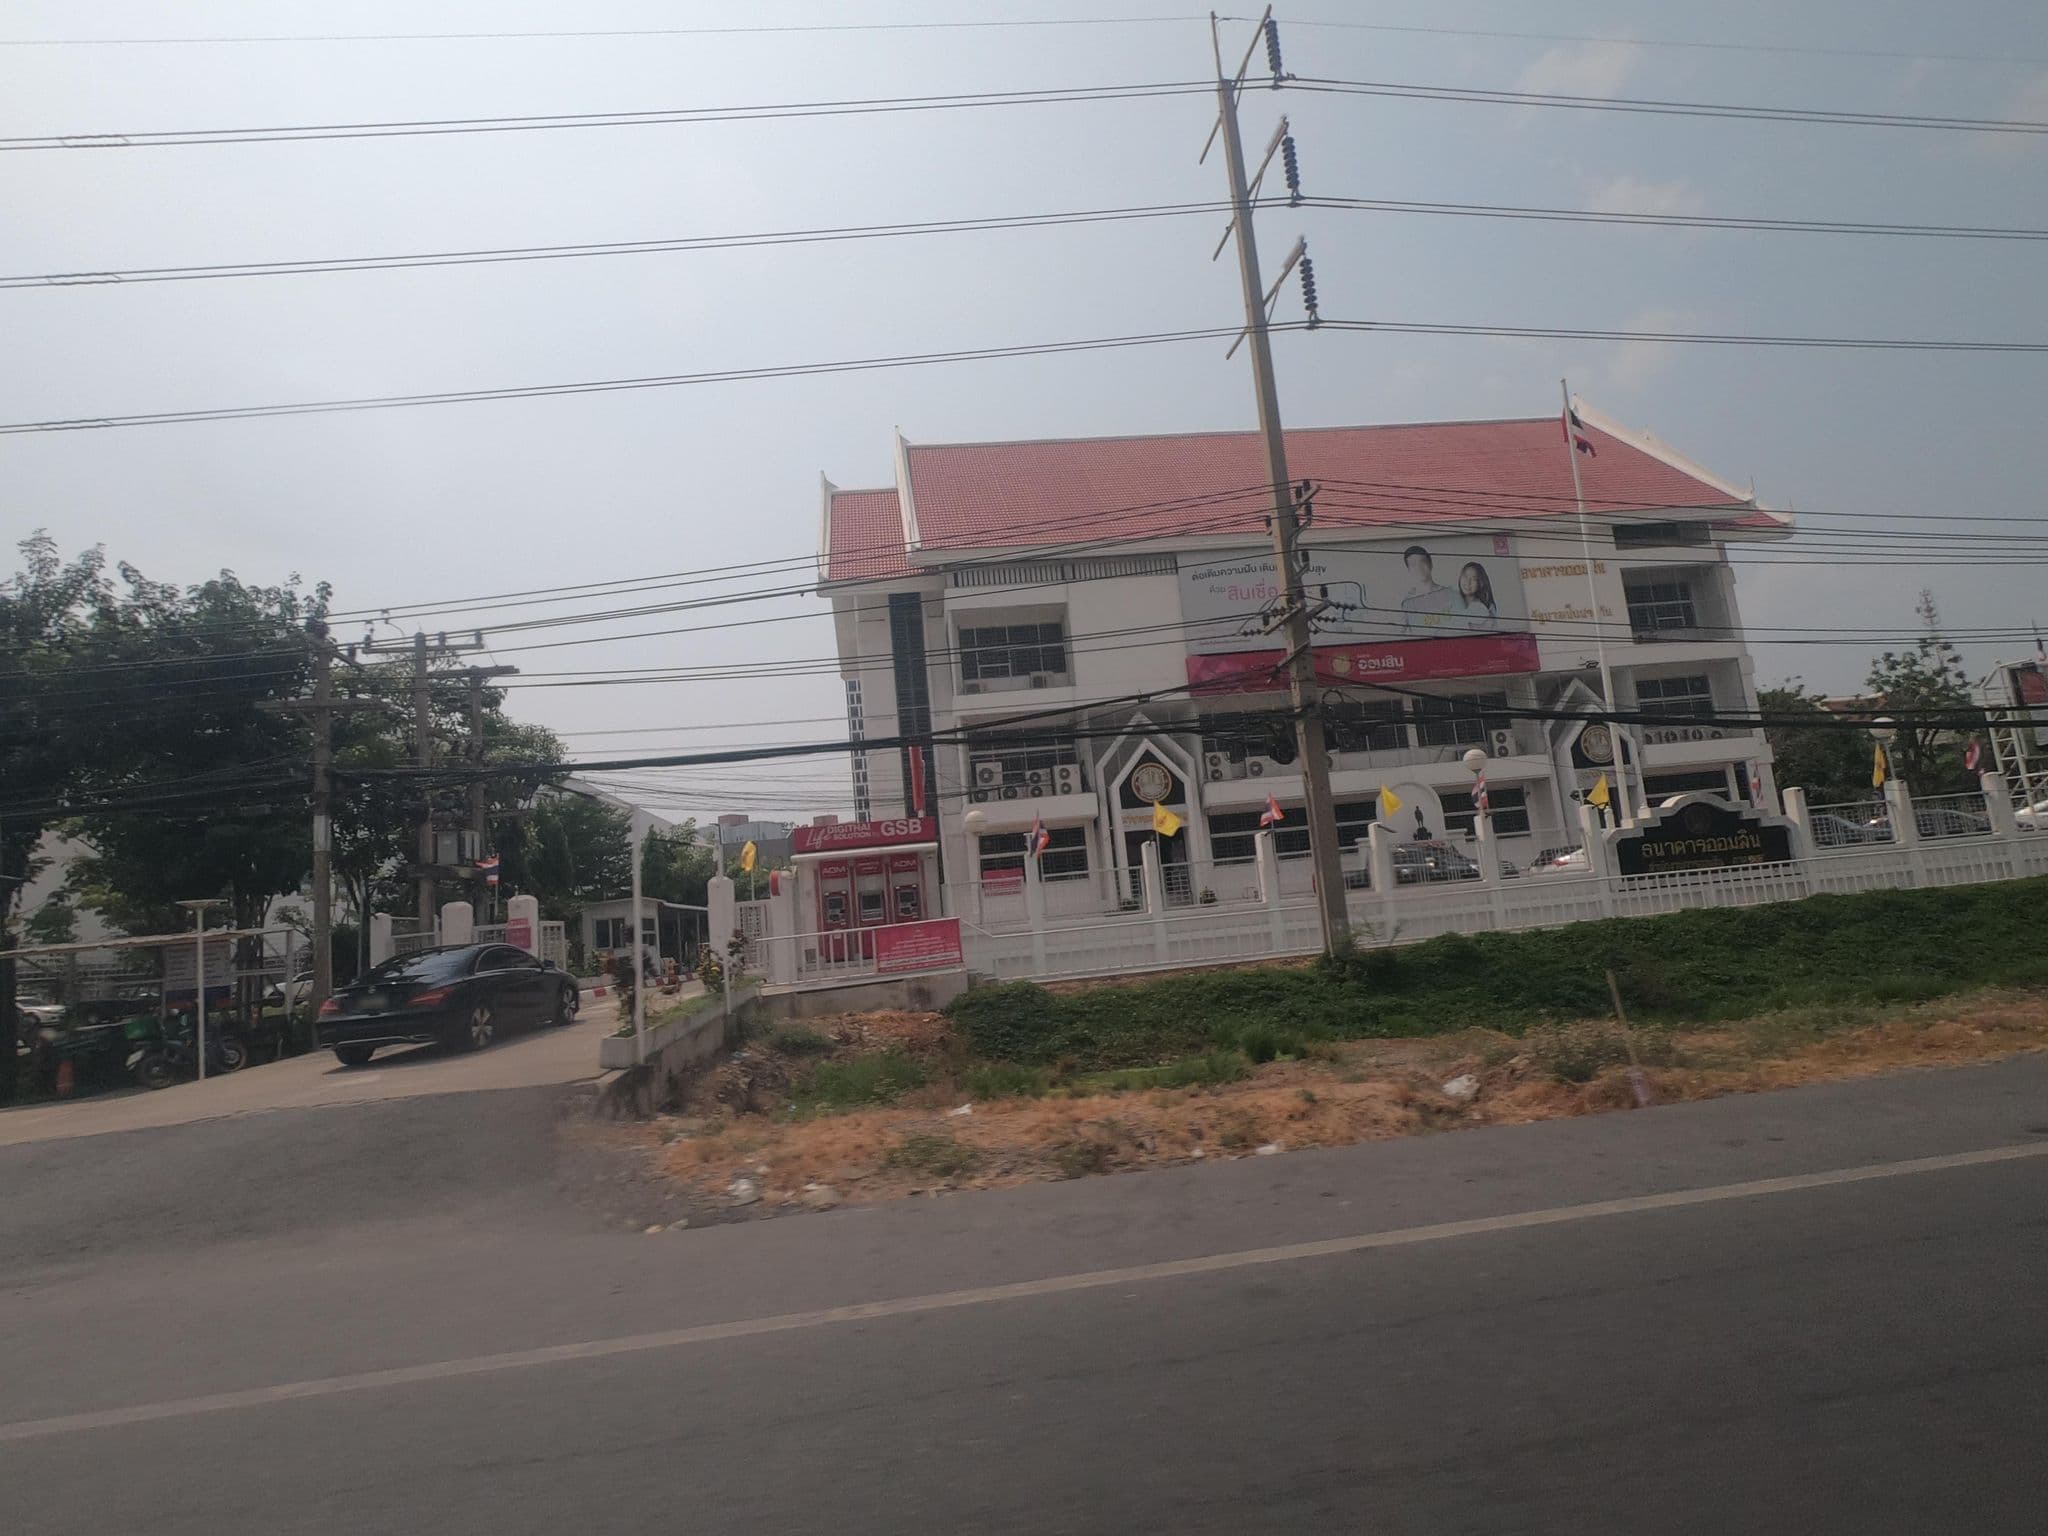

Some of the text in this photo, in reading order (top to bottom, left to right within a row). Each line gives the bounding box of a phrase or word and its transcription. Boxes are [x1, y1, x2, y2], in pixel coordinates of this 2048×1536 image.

[880, 819, 922, 837] GSB
[1641, 828, 1761, 857] ธนาคารออมสิน
